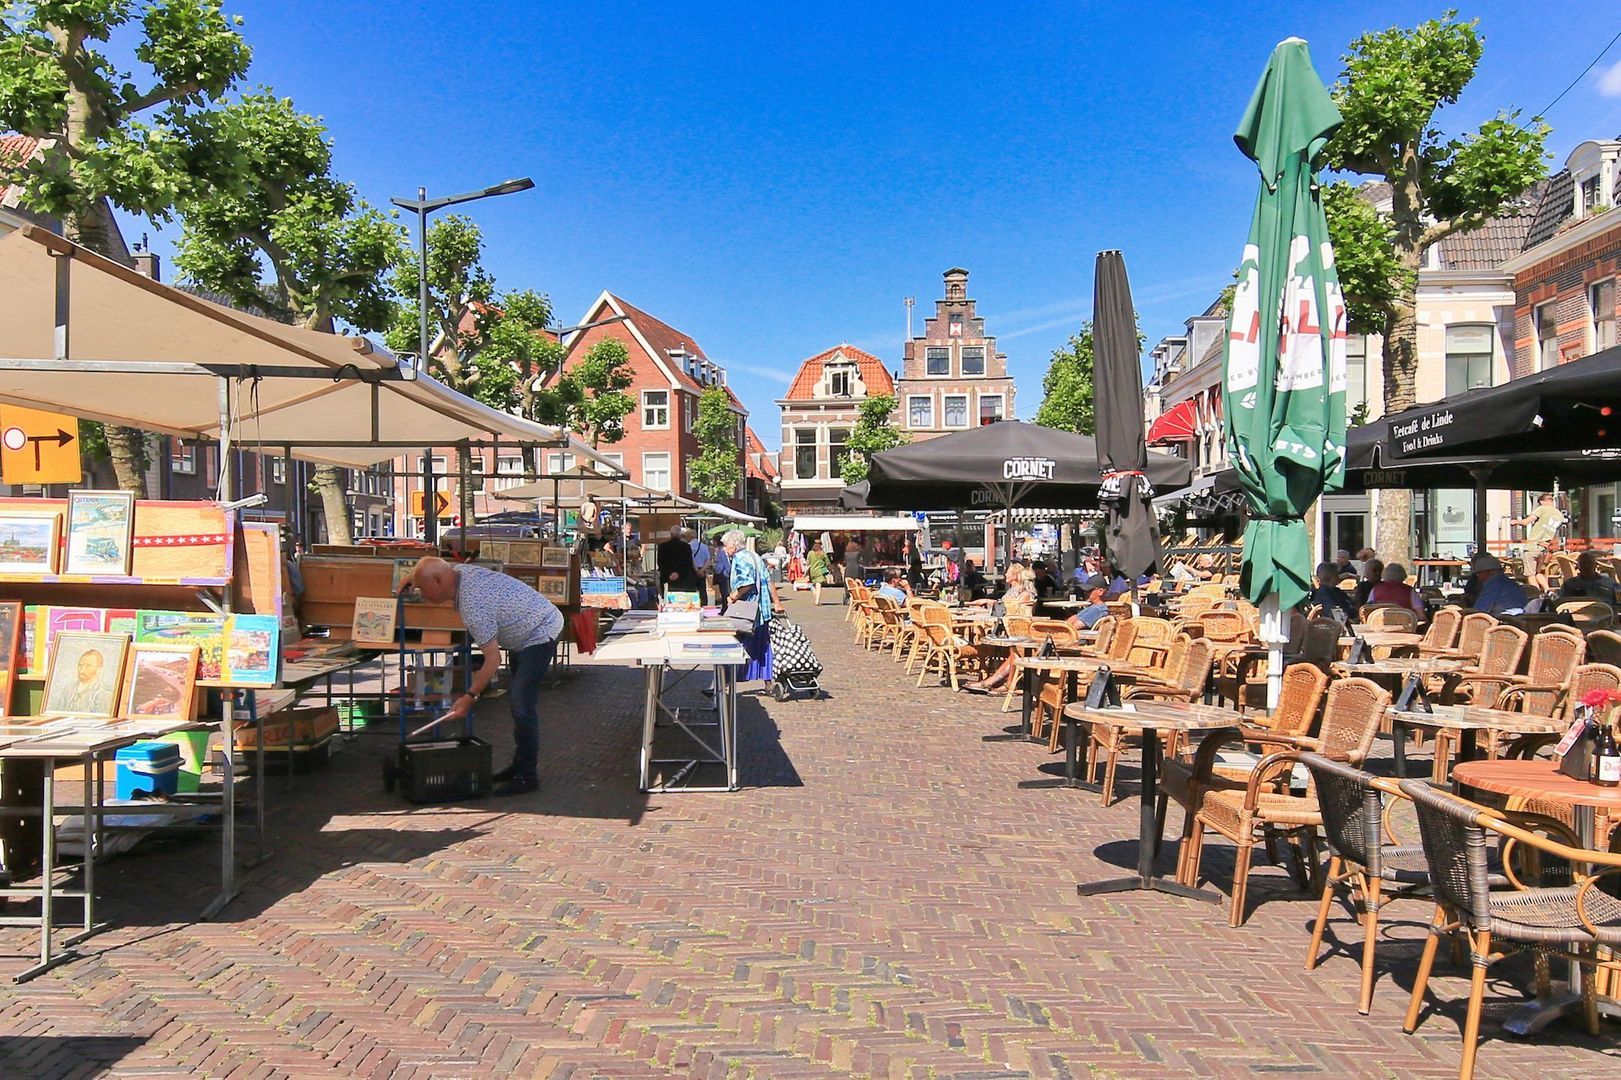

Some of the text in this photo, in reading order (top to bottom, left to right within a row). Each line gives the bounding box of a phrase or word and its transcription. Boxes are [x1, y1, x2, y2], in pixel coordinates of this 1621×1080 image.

[1421, 416, 1430, 431] de
[1431, 410, 1454, 428] Linde
[1422, 433, 1443, 447] Drinks
[1003, 460, 1056, 480] CORNET
[1363, 470, 1407, 486] CORNET
